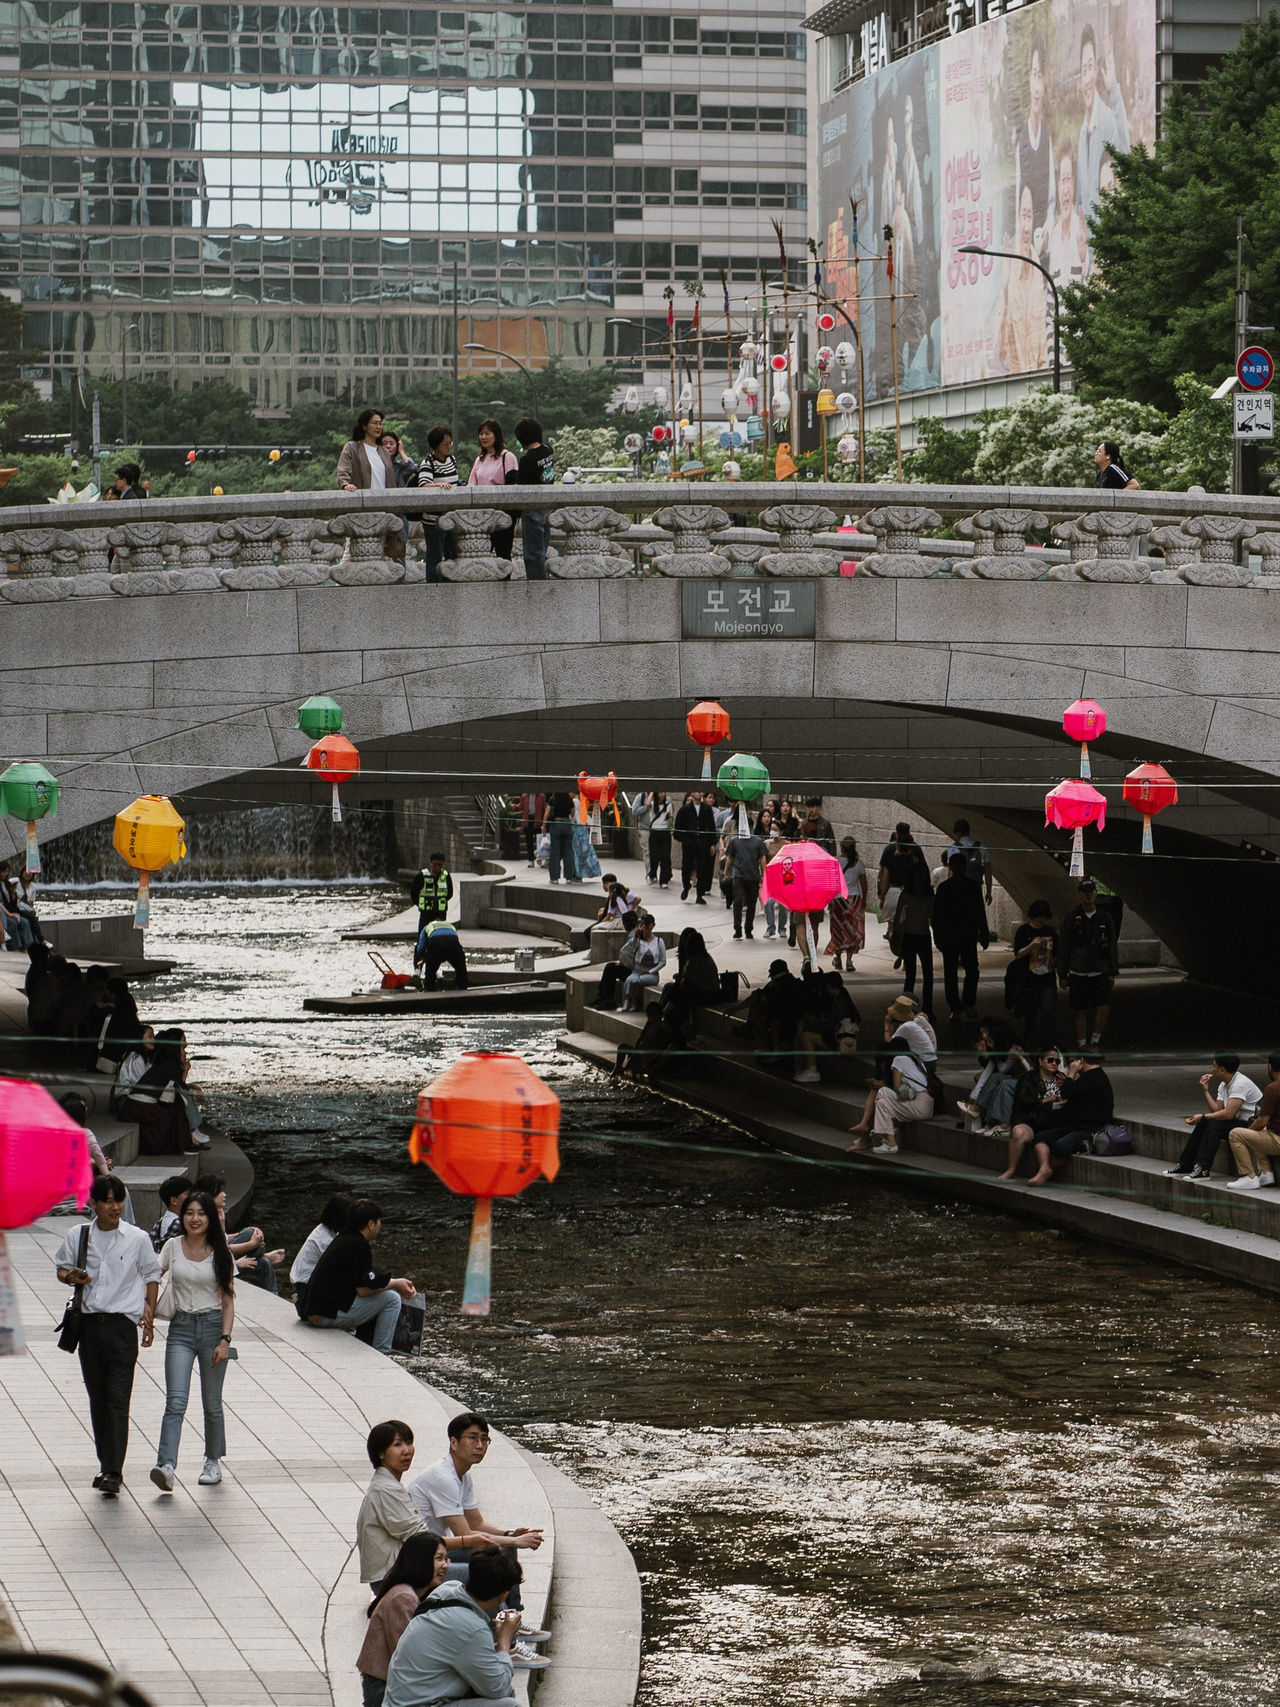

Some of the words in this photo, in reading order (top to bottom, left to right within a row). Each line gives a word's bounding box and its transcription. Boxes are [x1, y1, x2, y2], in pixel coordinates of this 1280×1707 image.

[945, 149, 981, 204] 아빠는
[1241, 365, 1269, 374] 주차금지
[1237, 398, 1271, 411] 견인지역
[702, 587, 795, 617] 모전교
[714, 620, 784, 635] Mojeongyo
